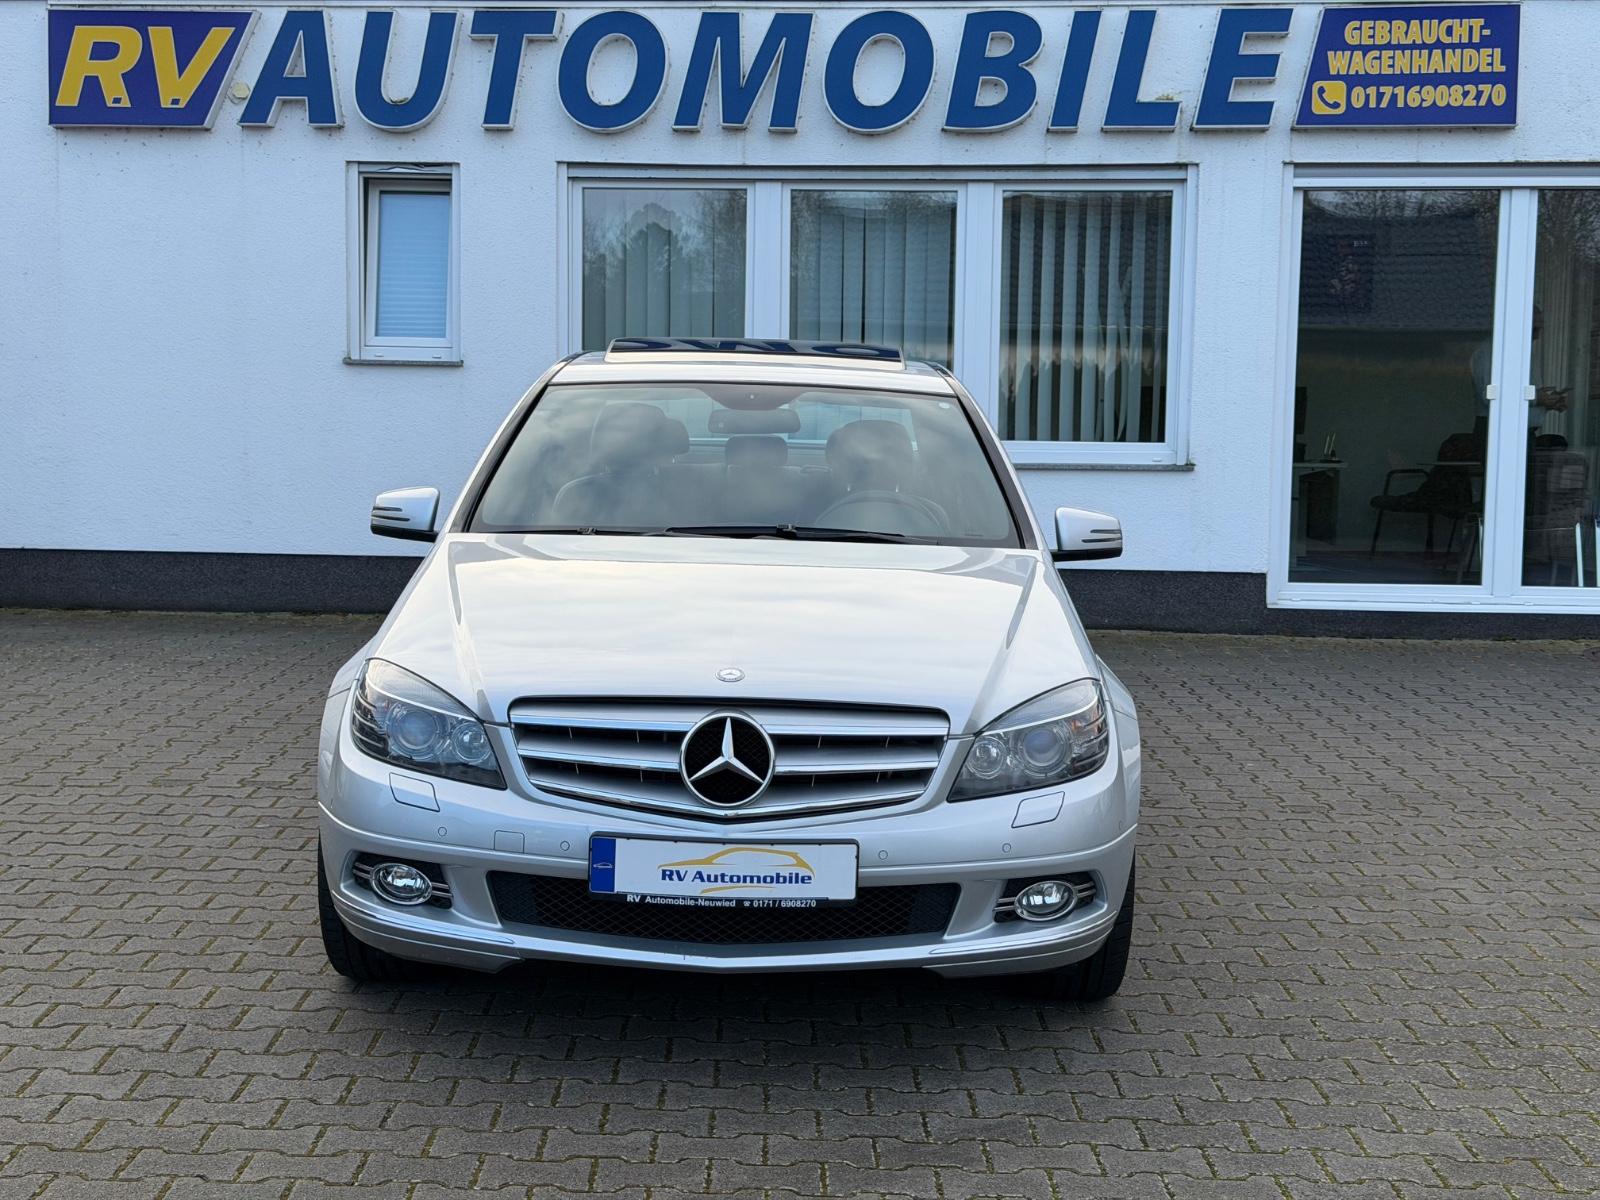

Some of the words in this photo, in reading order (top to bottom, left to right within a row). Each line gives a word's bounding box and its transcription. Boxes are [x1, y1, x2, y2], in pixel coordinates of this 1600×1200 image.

[1343, 18, 1492, 45] GEBRAUCHT-
[55, 25, 236, 109] RV
[238, 7, 1294, 134] AUTOMOBILE
[1327, 47, 1507, 75] WAGENHANDEL
[1350, 83, 1507, 109] 01716908270
[661, 868, 688, 882] RV
[691, 869, 813, 885] Automobile
[626, 894, 641, 903] RV
[645, 895, 736, 908] Automobile-Neuwied
[752, 899, 773, 908] 0171
[780, 899, 817, 908] 6908270
